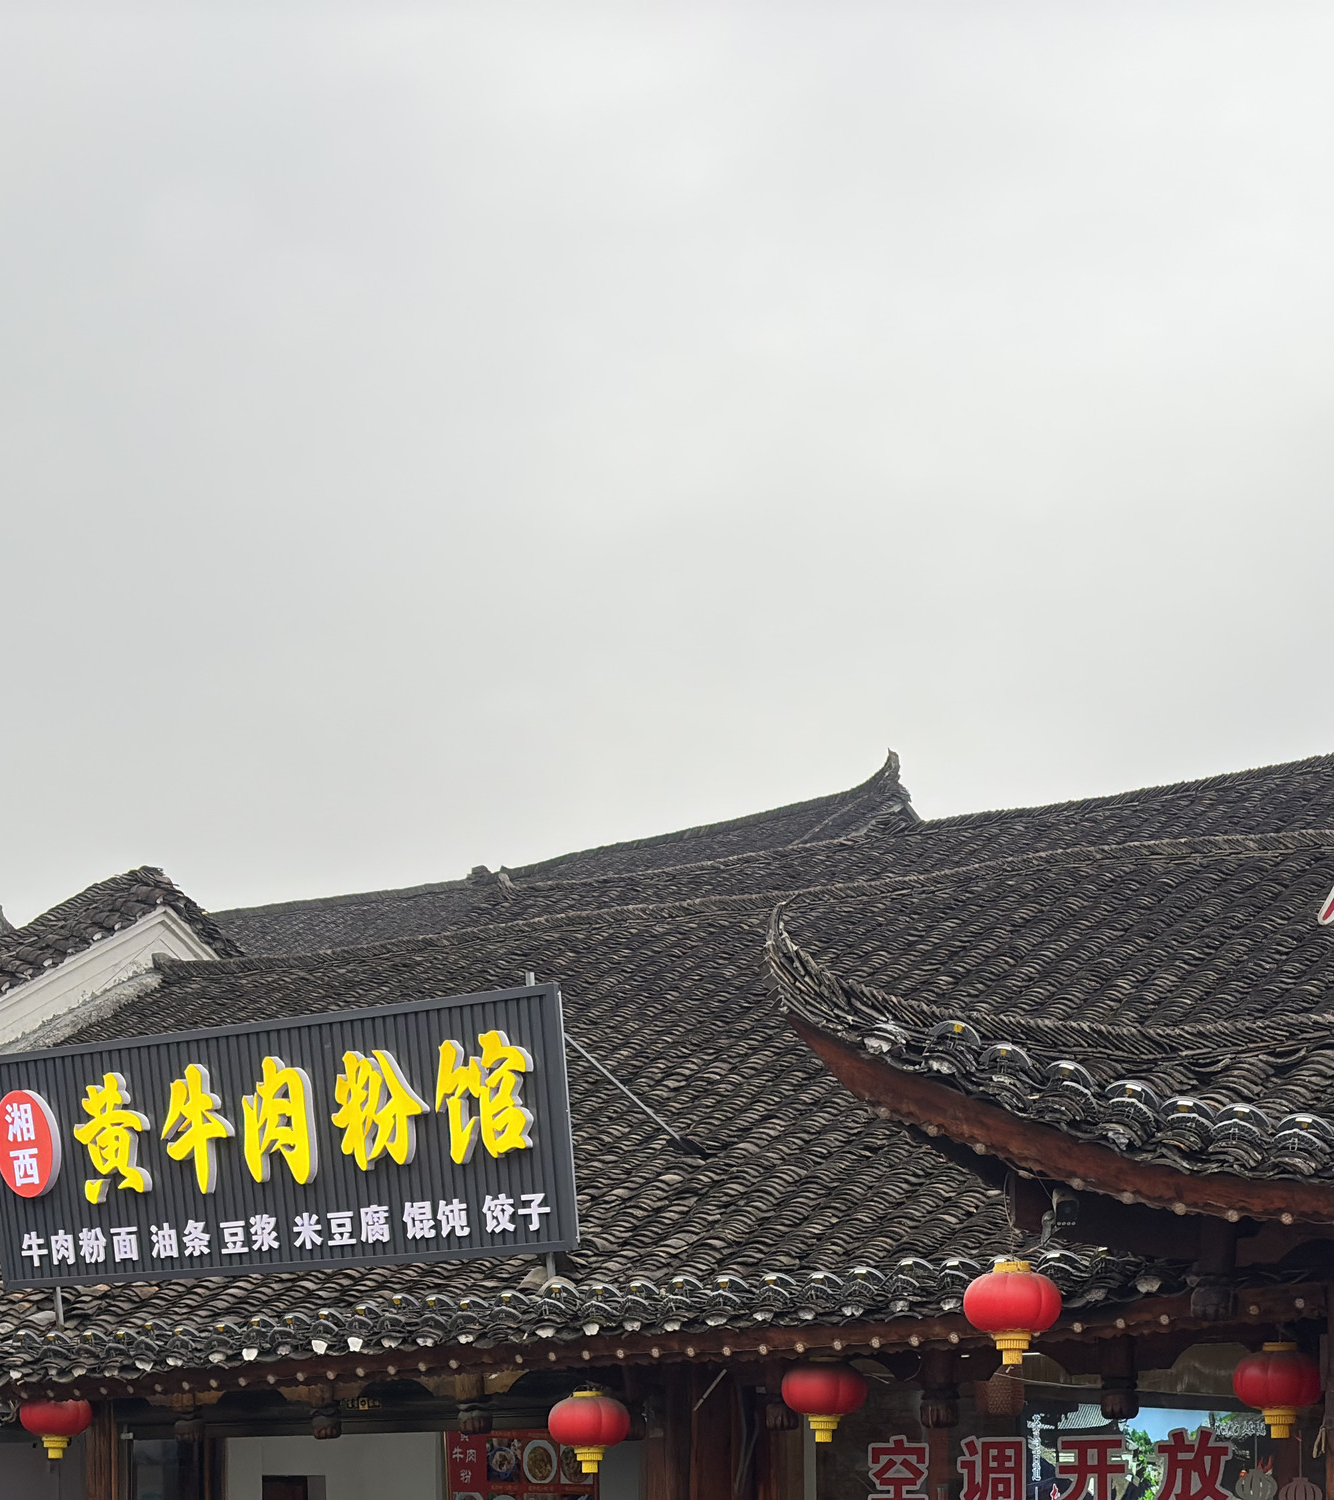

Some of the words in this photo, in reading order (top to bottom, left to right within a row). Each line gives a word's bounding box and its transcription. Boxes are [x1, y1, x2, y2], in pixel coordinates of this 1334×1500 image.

[4, 1101, 41, 1187] 湘西
[73, 1030, 534, 1205] 黄牛肉粉馆
[21, 1225, 139, 1269] 牛肉粉面
[151, 1220, 211, 1260] 油条
[220, 1214, 280, 1255] 豆浆
[293, 1205, 391, 1250] 米豆腐
[403, 1199, 470, 1242] 馄饨
[483, 1192, 551, 1233] 饺子
